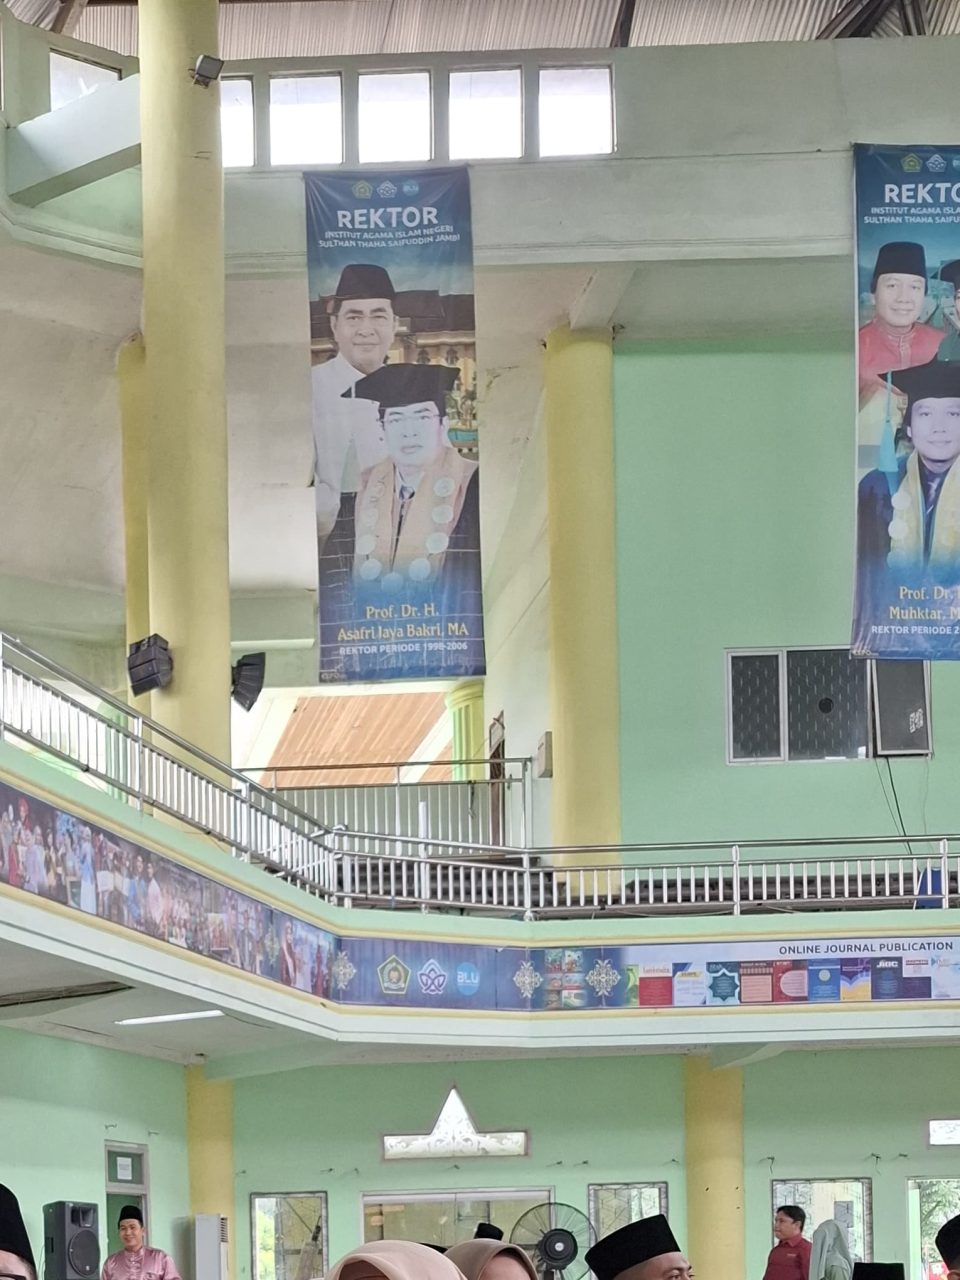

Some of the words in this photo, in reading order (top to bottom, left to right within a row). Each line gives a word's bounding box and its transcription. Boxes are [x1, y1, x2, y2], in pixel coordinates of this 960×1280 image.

[871, 206, 909, 215] INSTITUT
[910, 206, 942, 215] AGAMA
[337, 207, 438, 229] REKTOR
[864, 215, 903, 224] SULTHAN
[904, 215, 934, 224] THAHA
[324, 230, 361, 240] INSTITUT
[362, 231, 394, 239] AGAMA
[395, 229, 422, 239] ISLAM
[422, 225, 454, 237] NEGERI
[319, 239, 357, 248] SULTHAN
[358, 240, 387, 248] THAHA
[387, 236, 434, 248] SAIFUDDIN
[435, 233, 461, 243] JAMBI
[900, 586, 929, 600] Prof.
[934, 586, 954, 600] Dr.
[366, 606, 398, 619] Prof.
[401, 604, 421, 618] Dr.
[424, 603, 439, 616] H.
[338, 627, 376, 641] Asafri
[378, 626, 404, 640] Jaya
[448, 623, 469, 636] MA
[871, 625, 909, 634] REKTOR
[911, 626, 952, 635] PERIODE
[339, 646, 378, 655] REKTOR
[380, 643, 420, 653] PERIODE
[779, 944, 821, 955] ONLINE
[824, 944, 876, 954] JOURNAL
[879, 941, 954, 953] PUBLICATION
[457, 971, 479, 983] BLU
